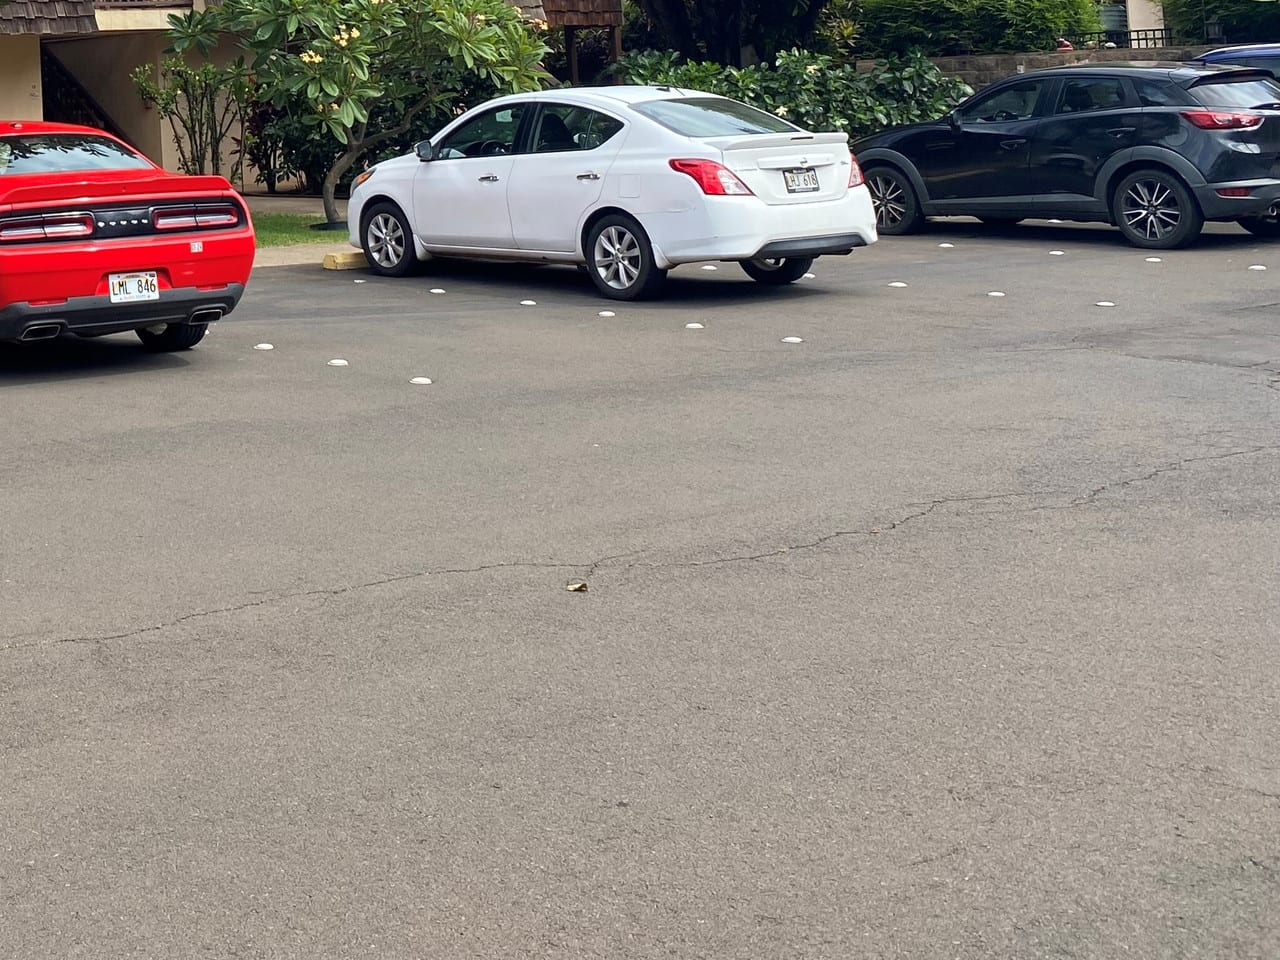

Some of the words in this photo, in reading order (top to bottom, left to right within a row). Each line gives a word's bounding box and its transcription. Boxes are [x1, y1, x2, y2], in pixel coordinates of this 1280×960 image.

[803, 174, 817, 186] 618
[112, 280, 132, 296] LML
[137, 278, 156, 293] 846
